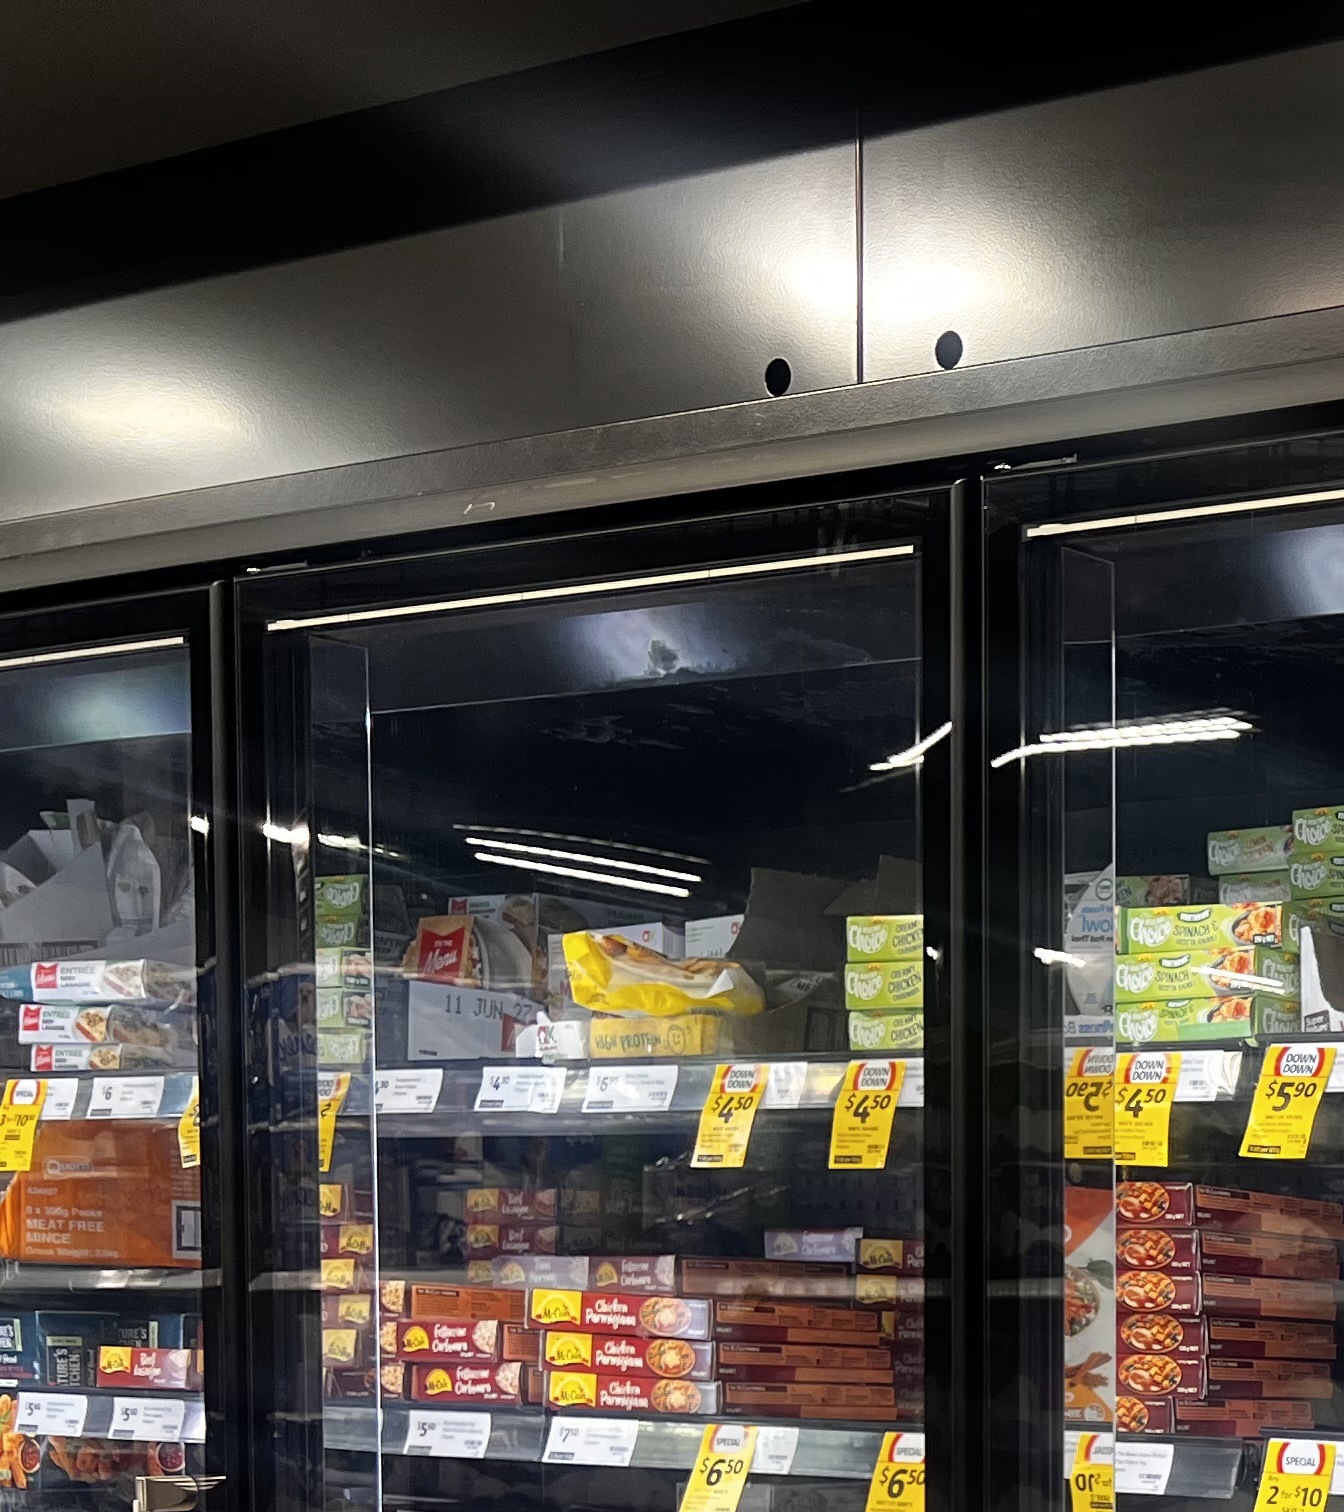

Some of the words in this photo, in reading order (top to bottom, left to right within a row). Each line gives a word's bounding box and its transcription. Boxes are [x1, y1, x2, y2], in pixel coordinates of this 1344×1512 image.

[445, 995, 462, 1014] 11
[473, 999, 503, 1018] JUN
[26, 1218, 68, 1230] MEAT
[68, 1220, 105, 1232] FREE
[26, 1232, 71, 1244] MINCE
